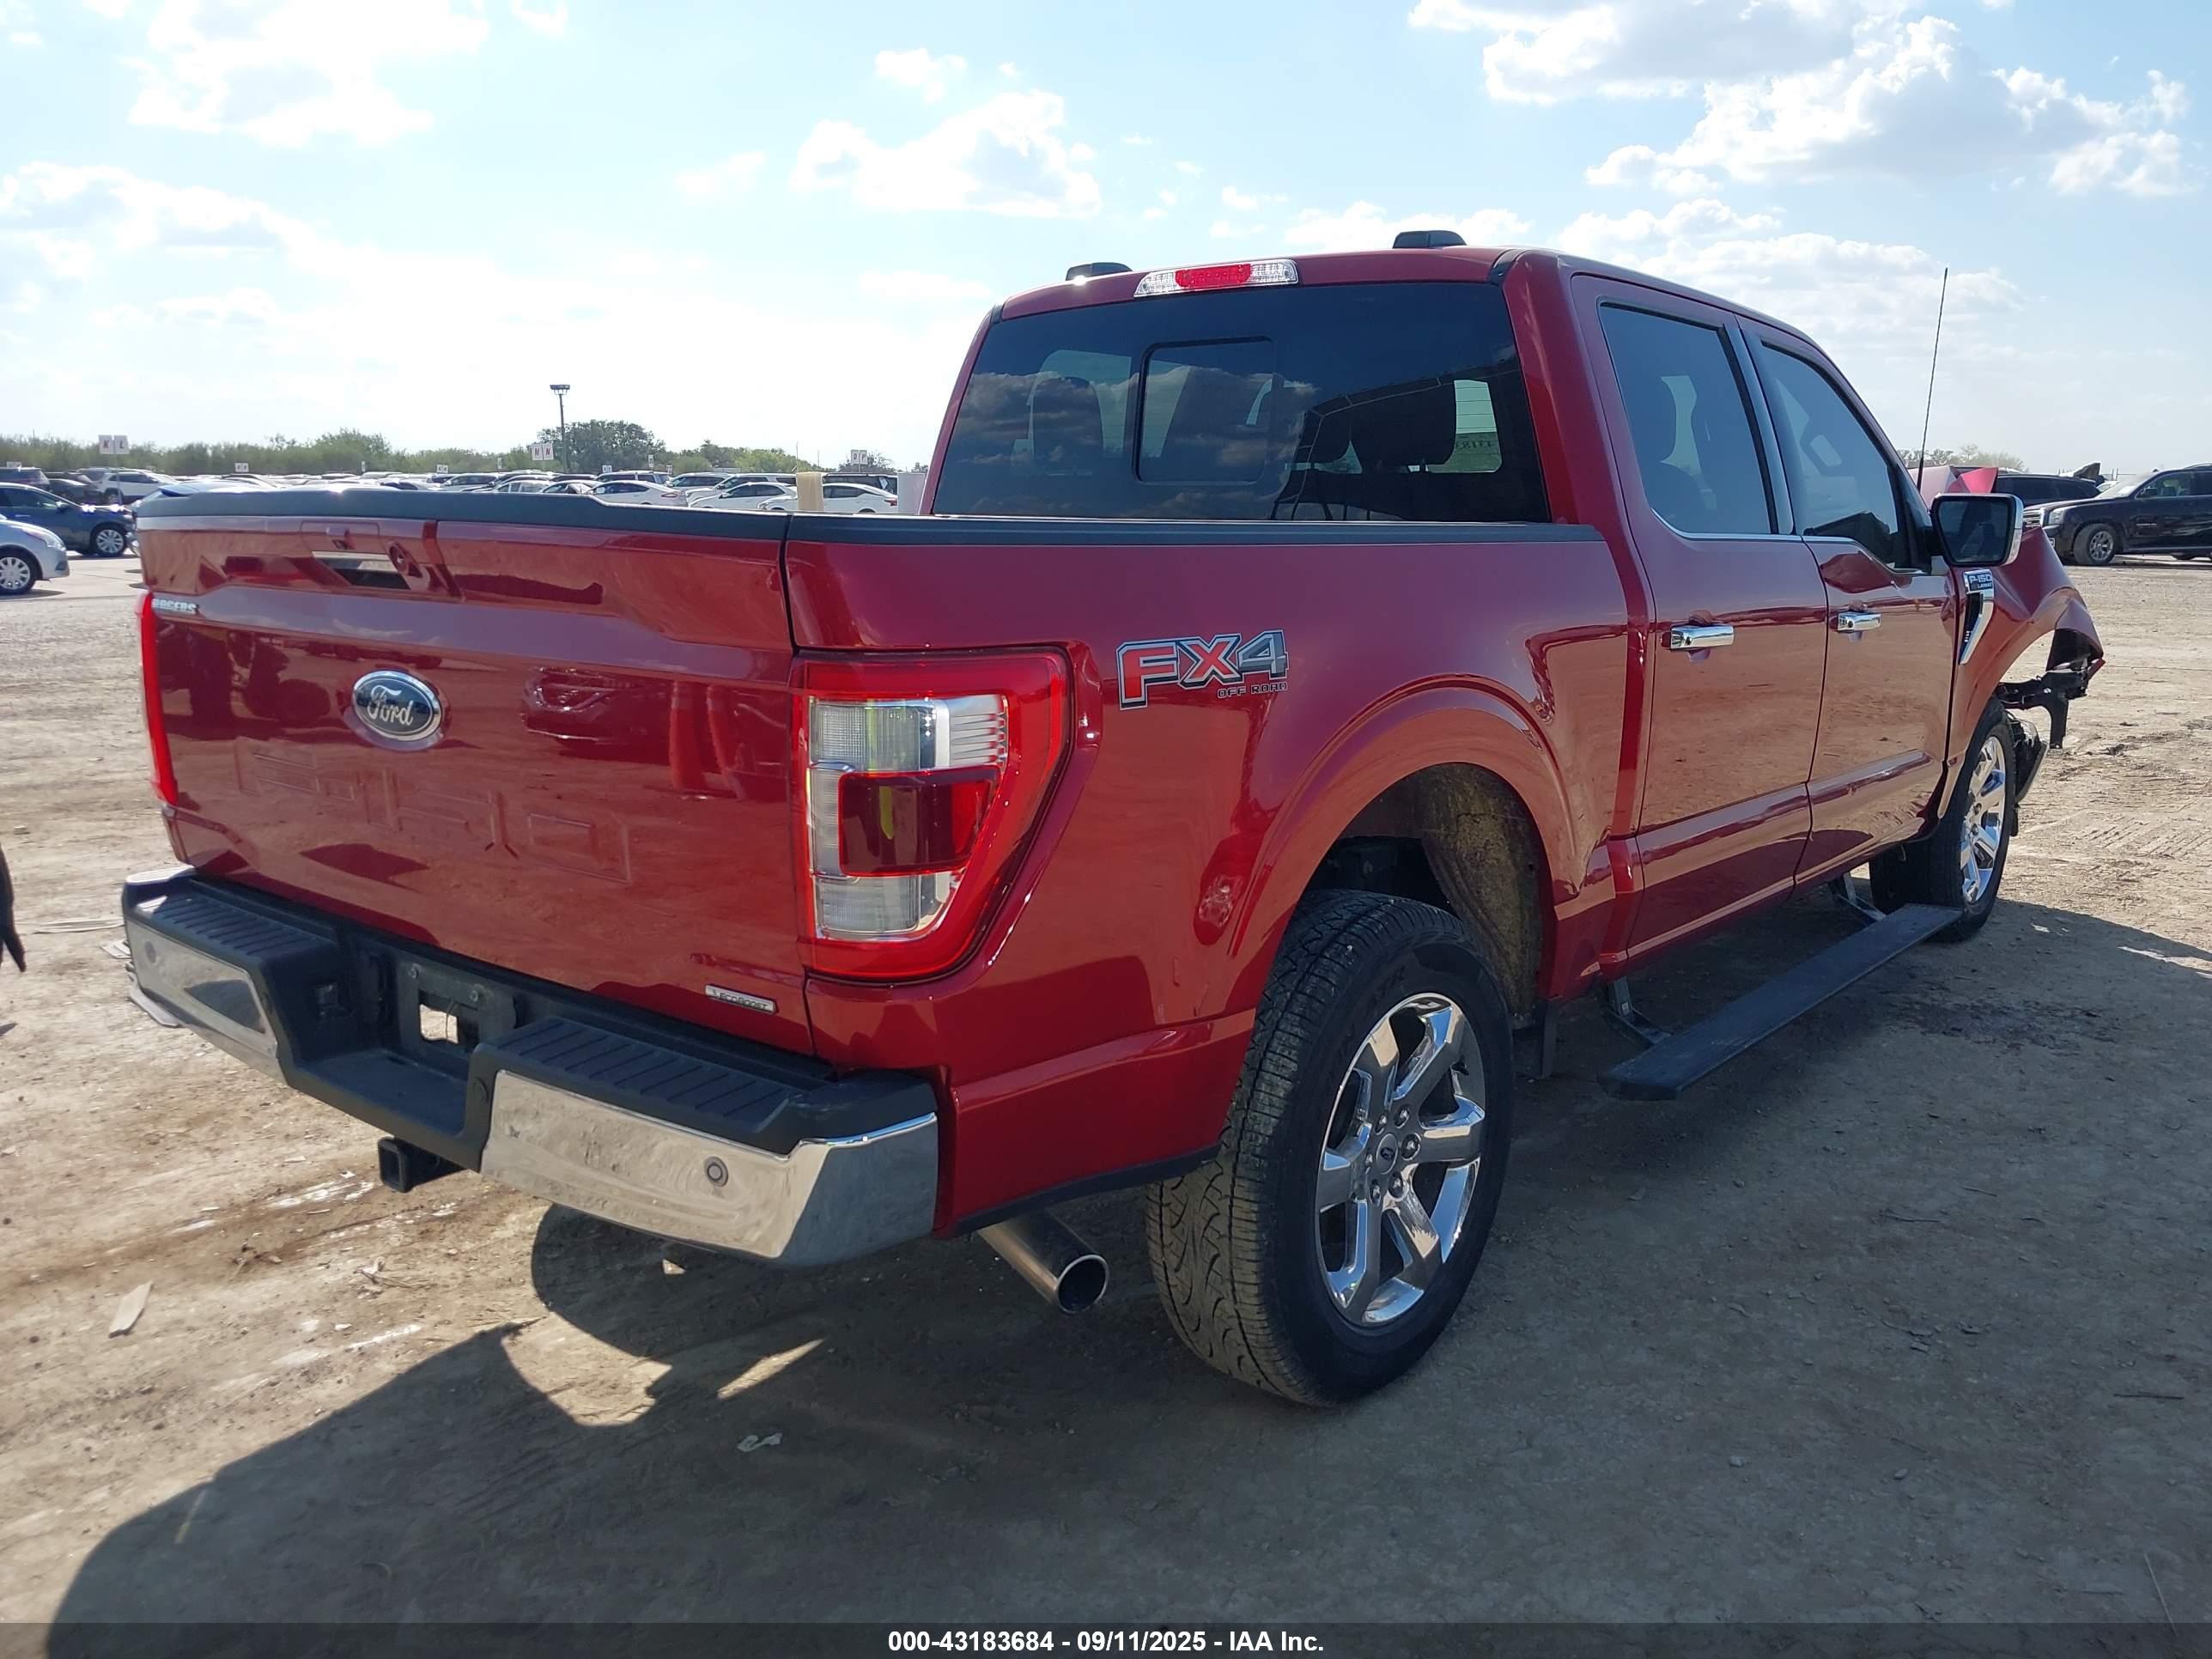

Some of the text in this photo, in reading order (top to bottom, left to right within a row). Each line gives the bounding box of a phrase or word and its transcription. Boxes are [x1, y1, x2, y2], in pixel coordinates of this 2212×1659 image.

[1115, 629, 1289, 711] FX4
[1217, 682, 1288, 699] OFF ROAD
[367, 684, 414, 726] Ford
